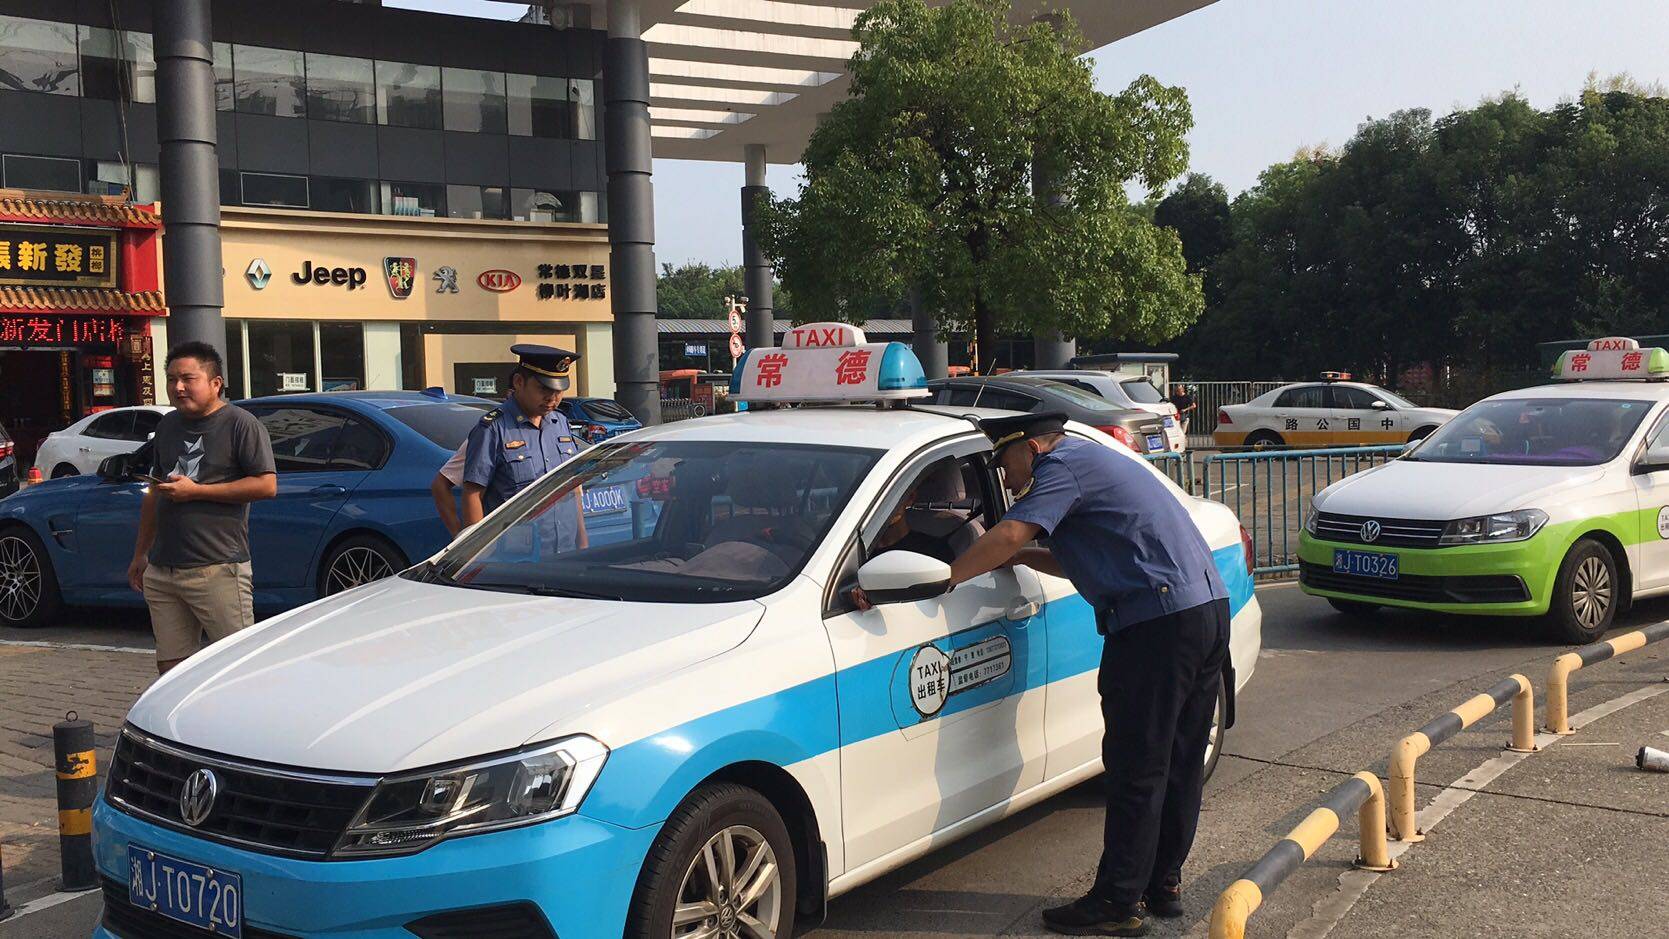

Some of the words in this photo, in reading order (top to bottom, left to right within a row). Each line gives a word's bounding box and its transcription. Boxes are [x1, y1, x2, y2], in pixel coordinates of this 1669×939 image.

[292, 260, 367, 290] Jeep
[483, 273, 516, 288] KIA
[792, 327, 843, 347] TAXI
[1594, 340, 1626, 350] TAXI
[917, 660, 942, 679] TAXI
[917, 677, 946, 700] 出租车
